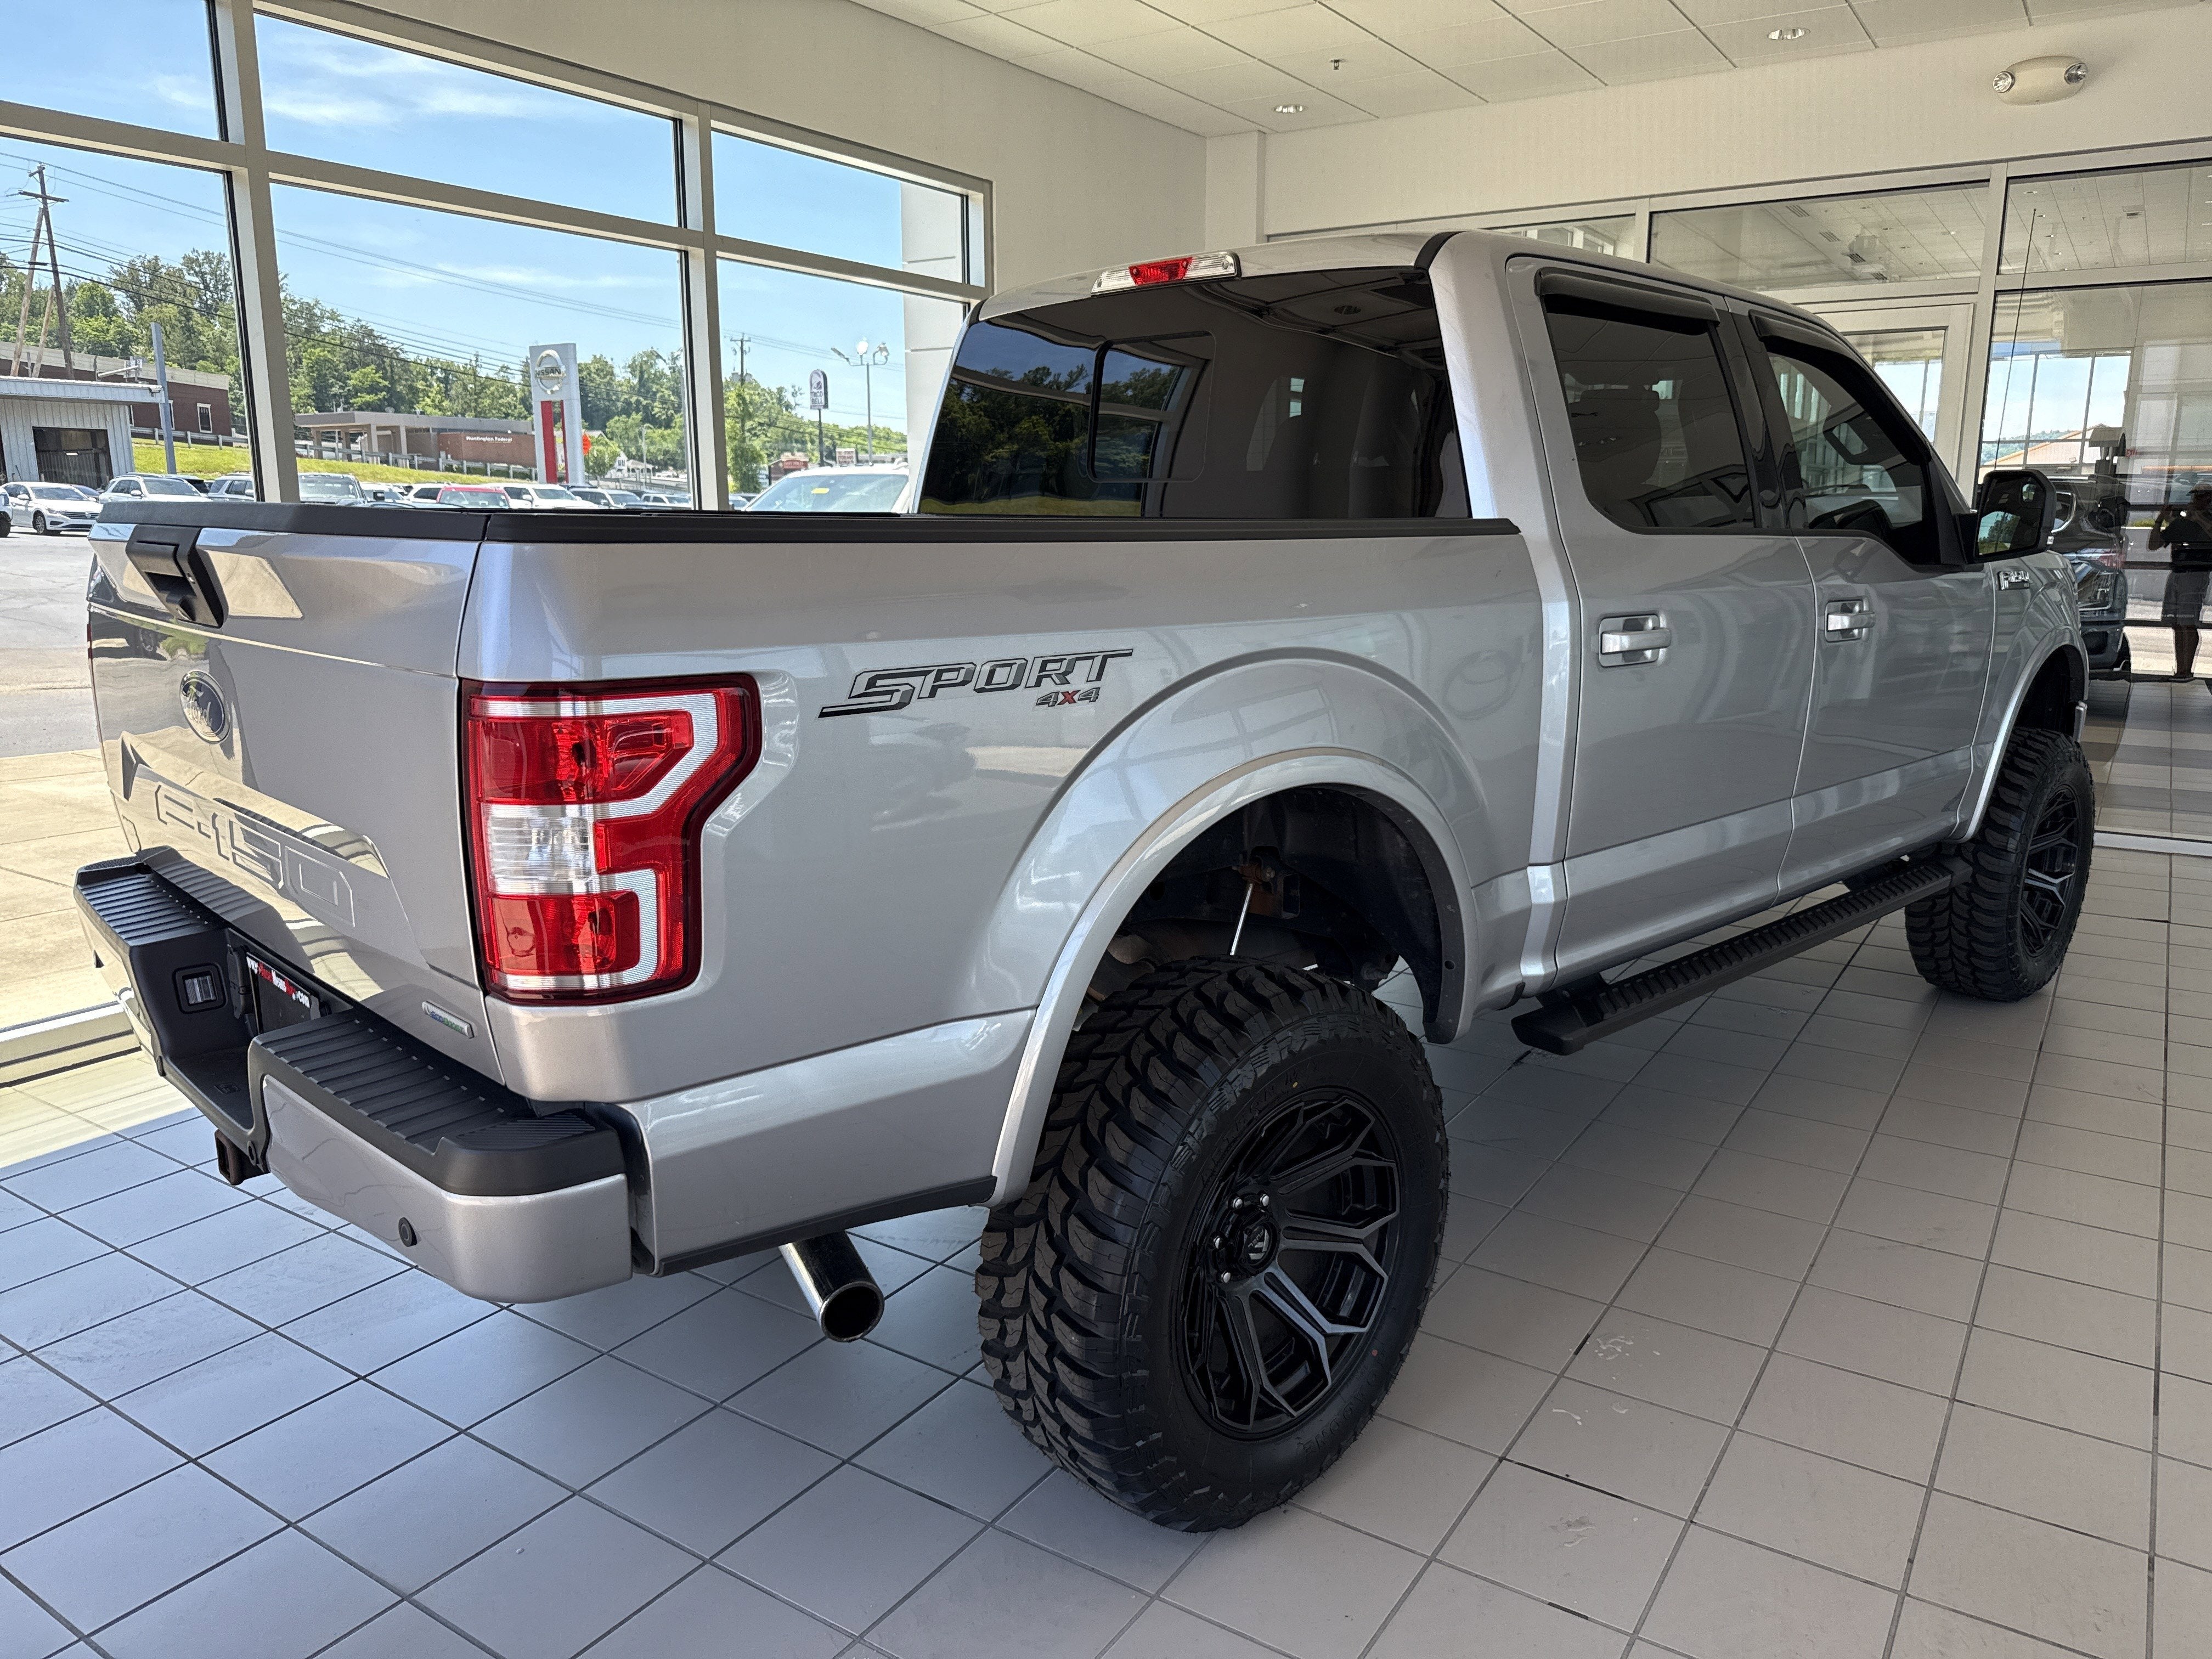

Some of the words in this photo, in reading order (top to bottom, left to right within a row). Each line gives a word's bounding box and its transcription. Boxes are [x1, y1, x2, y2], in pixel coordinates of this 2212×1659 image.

[535, 368, 561, 377] NISSAN
[183, 684, 212, 726] Ford
[818, 648, 1133, 719] SPORT
[155, 782, 356, 928] F-150
